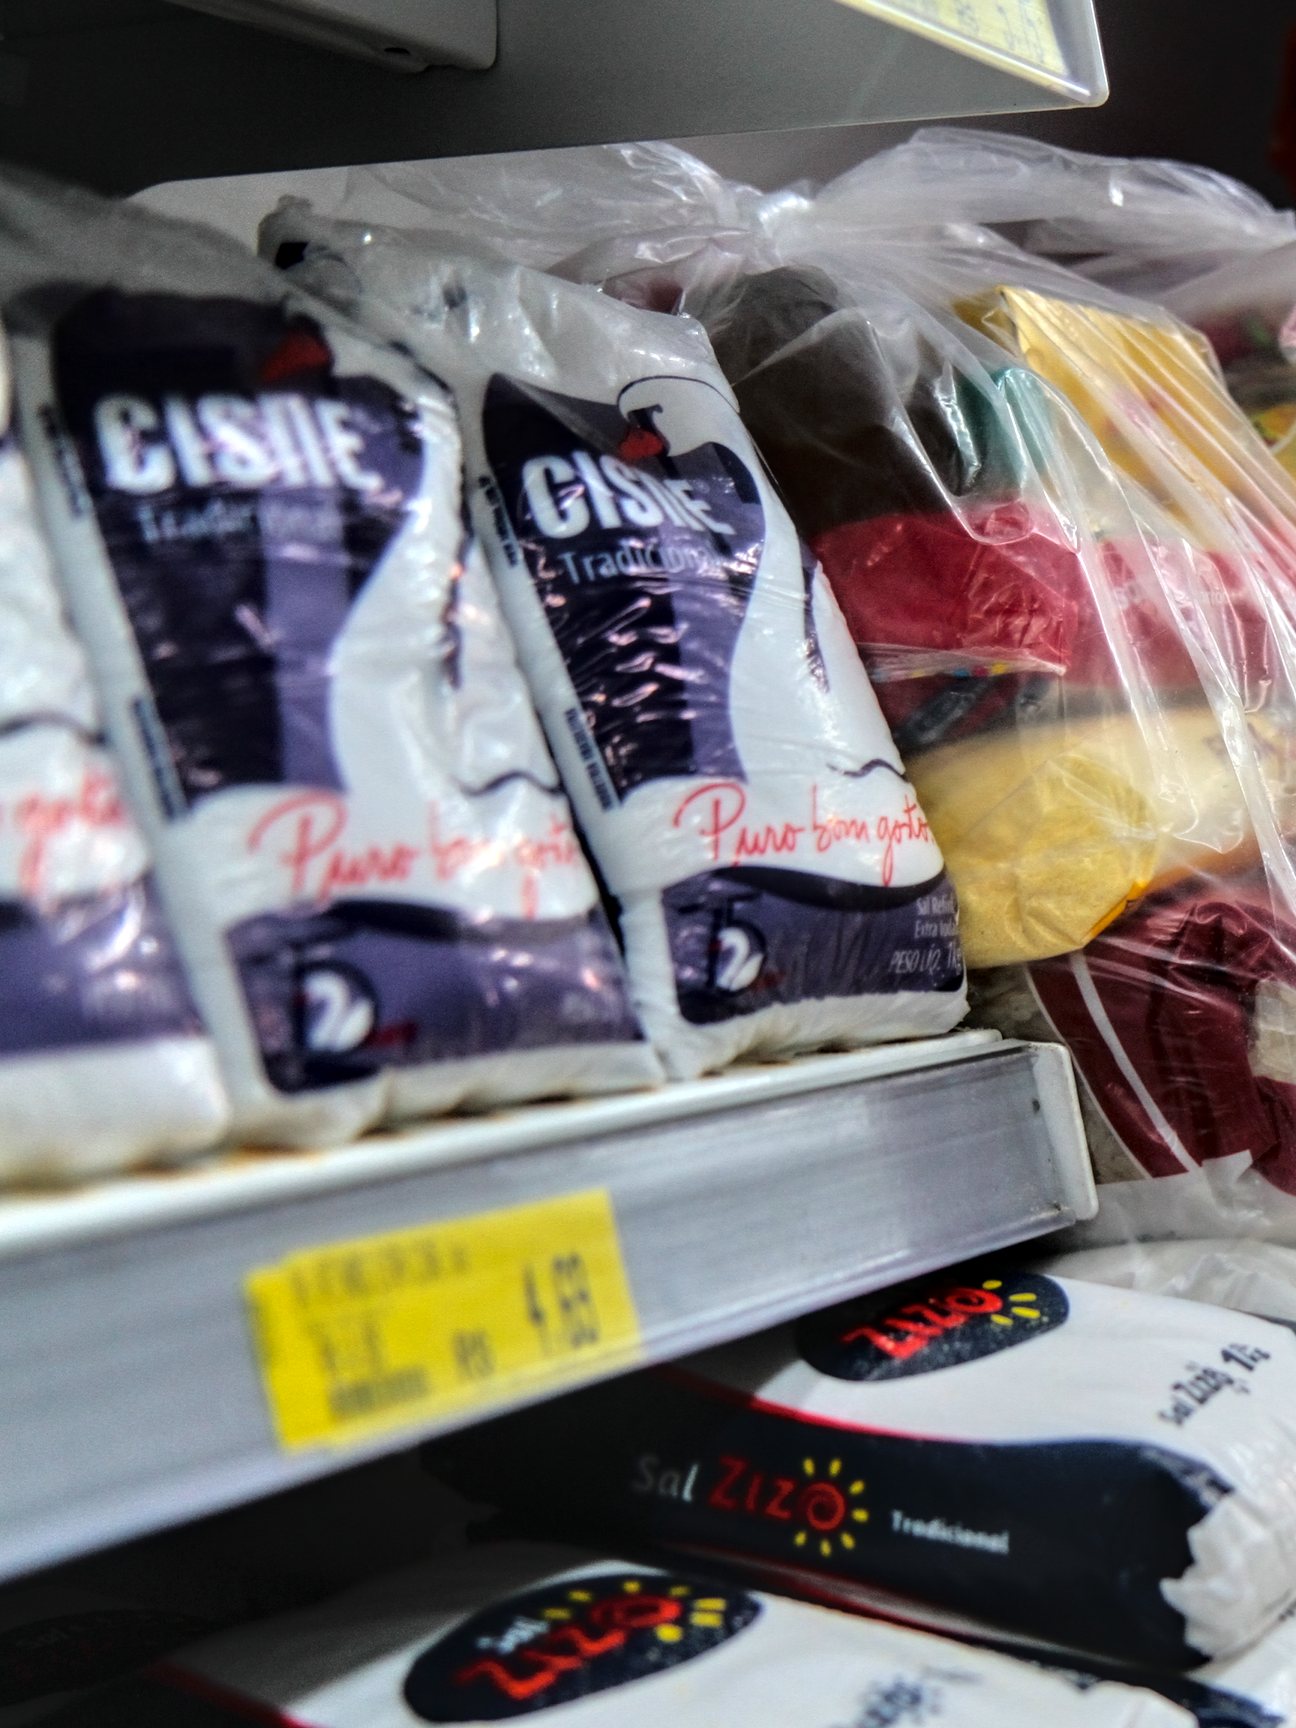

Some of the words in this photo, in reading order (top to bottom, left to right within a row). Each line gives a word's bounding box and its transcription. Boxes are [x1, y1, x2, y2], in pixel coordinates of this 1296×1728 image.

[671, 781, 805, 868] Puro
[812, 783, 870, 853] bom
[887, 950, 920, 974] PESO
[631, 1454, 699, 1503] Sal
[892, 1508, 1010, 1555] Tradicional
